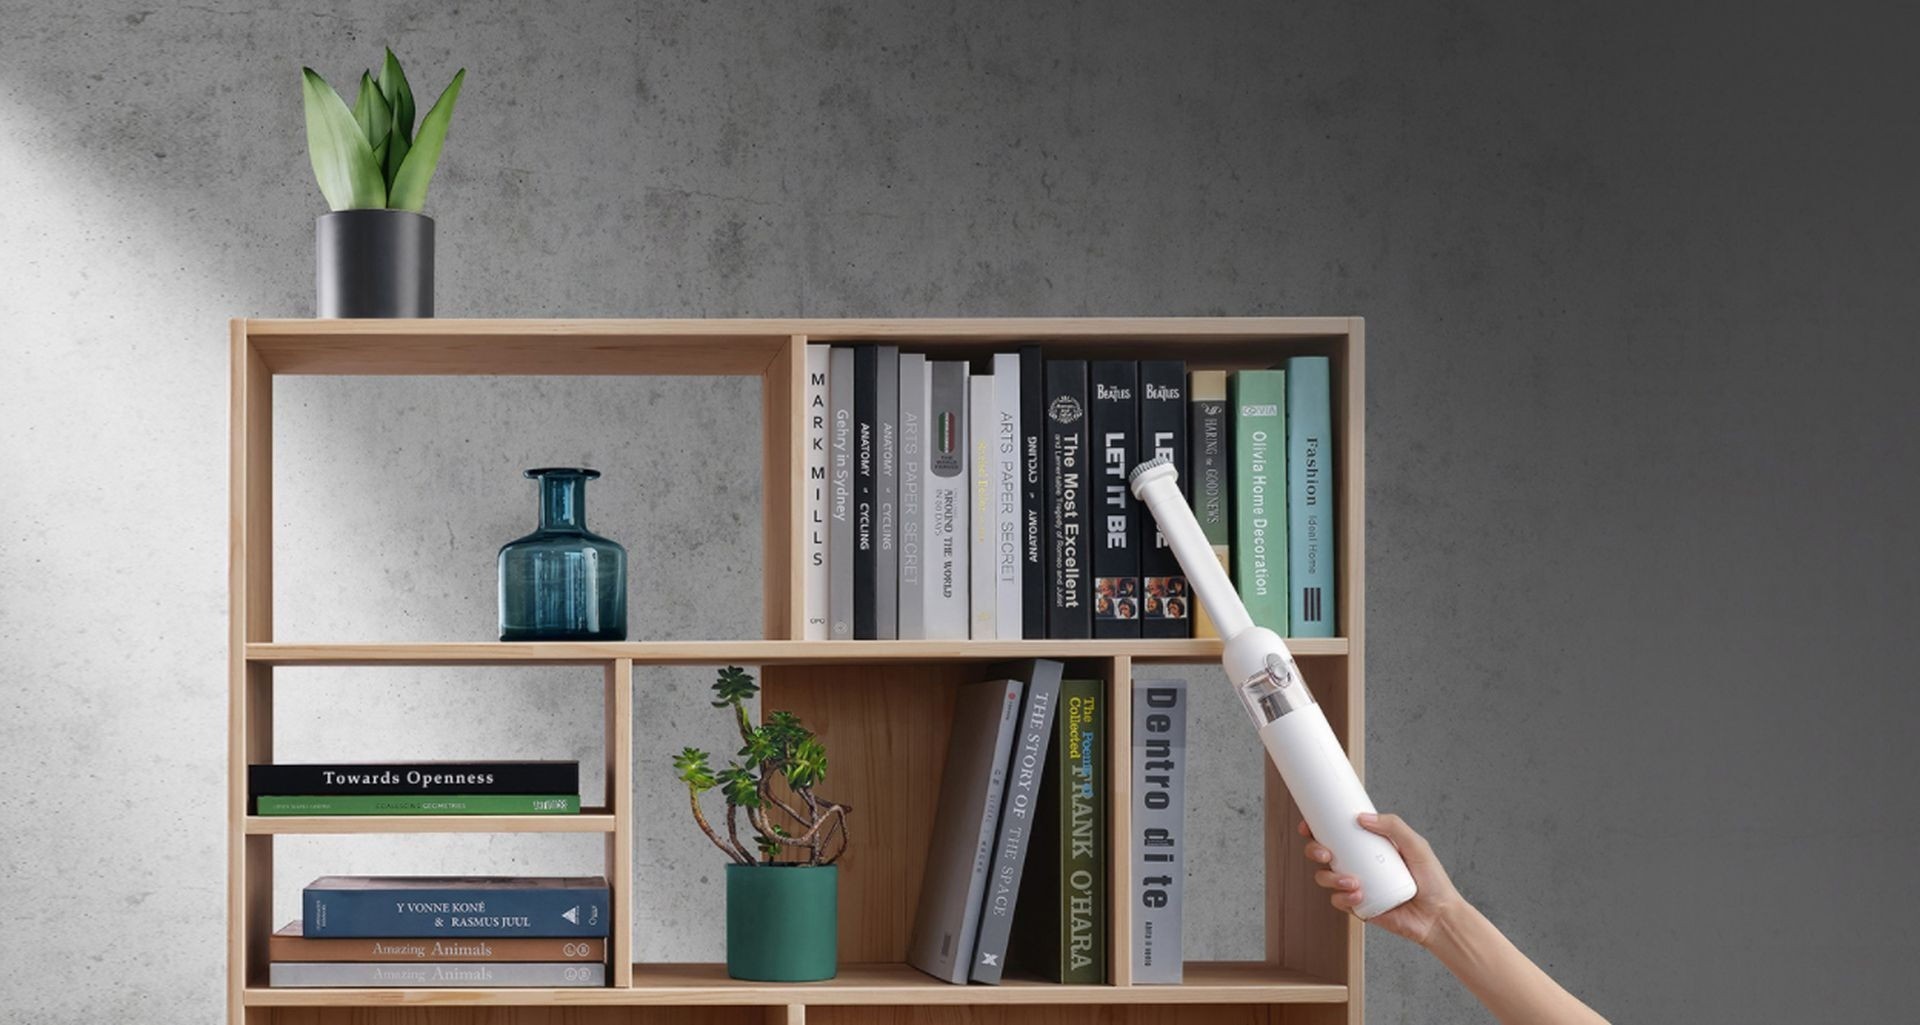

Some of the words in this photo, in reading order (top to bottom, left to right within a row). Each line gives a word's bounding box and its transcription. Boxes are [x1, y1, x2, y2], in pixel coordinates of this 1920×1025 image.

[811, 373, 825, 450] MARK
[834, 409, 849, 448] Gehry
[860, 423, 870, 477] ANATOMY
[883, 423, 893, 477] ANATOMY
[905, 413, 918, 456] ARTS
[1001, 412, 1014, 453] ARTS
[1064, 433, 1078, 467] The
[1252, 431, 1267, 472] Olivia
[837, 451, 848, 467] in
[1028, 436, 1038, 484] CYCLING
[1105, 432, 1125, 480] LET
[1306, 438, 1319, 506] Fashion
[833, 470, 849, 521] Sydney
[905, 463, 918, 515] PAPER
[935, 489, 943, 499] IN
[1001, 462, 1014, 515] PAPER
[1064, 473, 1079, 518] Most
[1106, 486, 1125, 509] IT
[1252, 476, 1267, 515] Home
[811, 467, 825, 566] MILLS
[860, 504, 870, 550] CYCLING
[882, 504, 892, 550] CYCLING
[934, 513, 943, 536] DAYS
[944, 489, 953, 533] AROUND
[1053, 498, 1063, 528] Tragedy
[1308, 515, 1317, 540] Ideal
[944, 537, 953, 557] THE
[1029, 509, 1039, 563] ANATOMY
[1055, 531, 1063, 539] of
[1107, 516, 1127, 549] BE
[904, 523, 918, 586] SECRET
[1001, 523, 1014, 585] SECRET
[1064, 523, 1080, 608] Excellent
[1253, 519, 1268, 596] Decoration
[1308, 544, 1317, 574] Home
[944, 561, 953, 599] WORLD
[1029, 692, 1048, 729] THE
[1069, 697, 1081, 759] Collected
[1083, 697, 1095, 723] The
[1018, 733, 1041, 790] STORY
[1144, 688, 1177, 810] Dentro
[324, 771, 400, 785] Towards
[407, 771, 494, 788] Openness
[1012, 795, 1028, 819] OF
[1072, 765, 1094, 860] FRANK
[1004, 828, 1021, 859] THE
[1144, 828, 1174, 863] di
[396, 903, 405, 912] Y
[407, 903, 450, 913] VONNE
[452, 901, 486, 913] KONÉ
[993, 867, 1013, 917] SPACE
[1142, 876, 1174, 909] te
[434, 917, 444, 927] &
[451, 917, 499, 927] RASMUS
[501, 917, 531, 928] JUUL
[1070, 871, 1093, 971] O'HARA
[372, 943, 425, 957] Amazing
[431, 942, 492, 957] Animals
[373, 967, 425, 981] Amazing
[431, 967, 492, 981] Animals
